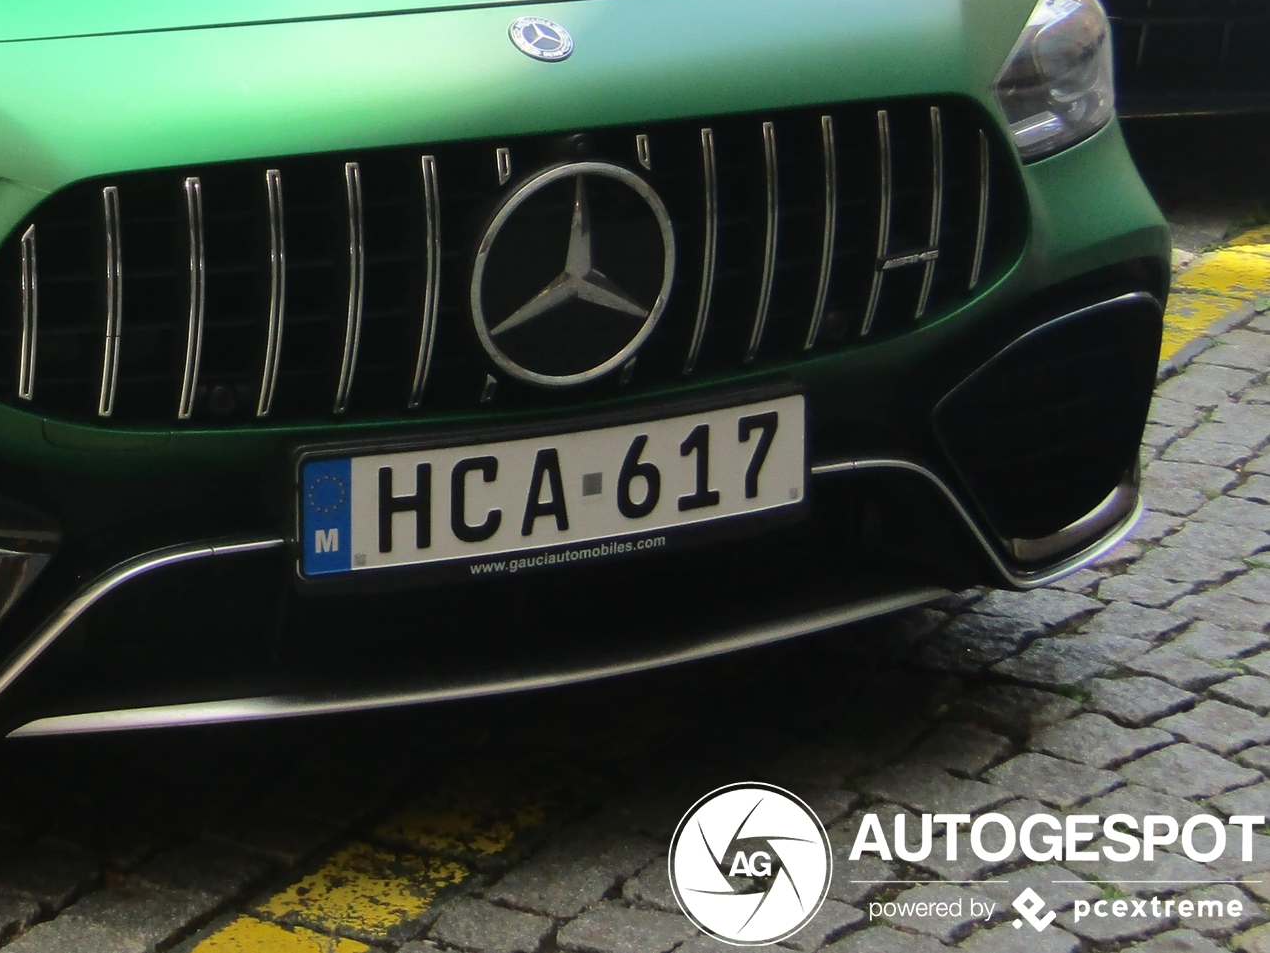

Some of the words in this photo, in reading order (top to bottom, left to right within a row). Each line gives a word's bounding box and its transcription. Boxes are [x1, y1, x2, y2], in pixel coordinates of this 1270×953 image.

[378, 447, 570, 554] HCA
[616, 410, 780, 520] 617
[315, 529, 338, 554] M
[469, 534, 667, 576] www.gauciautomobiles.com
